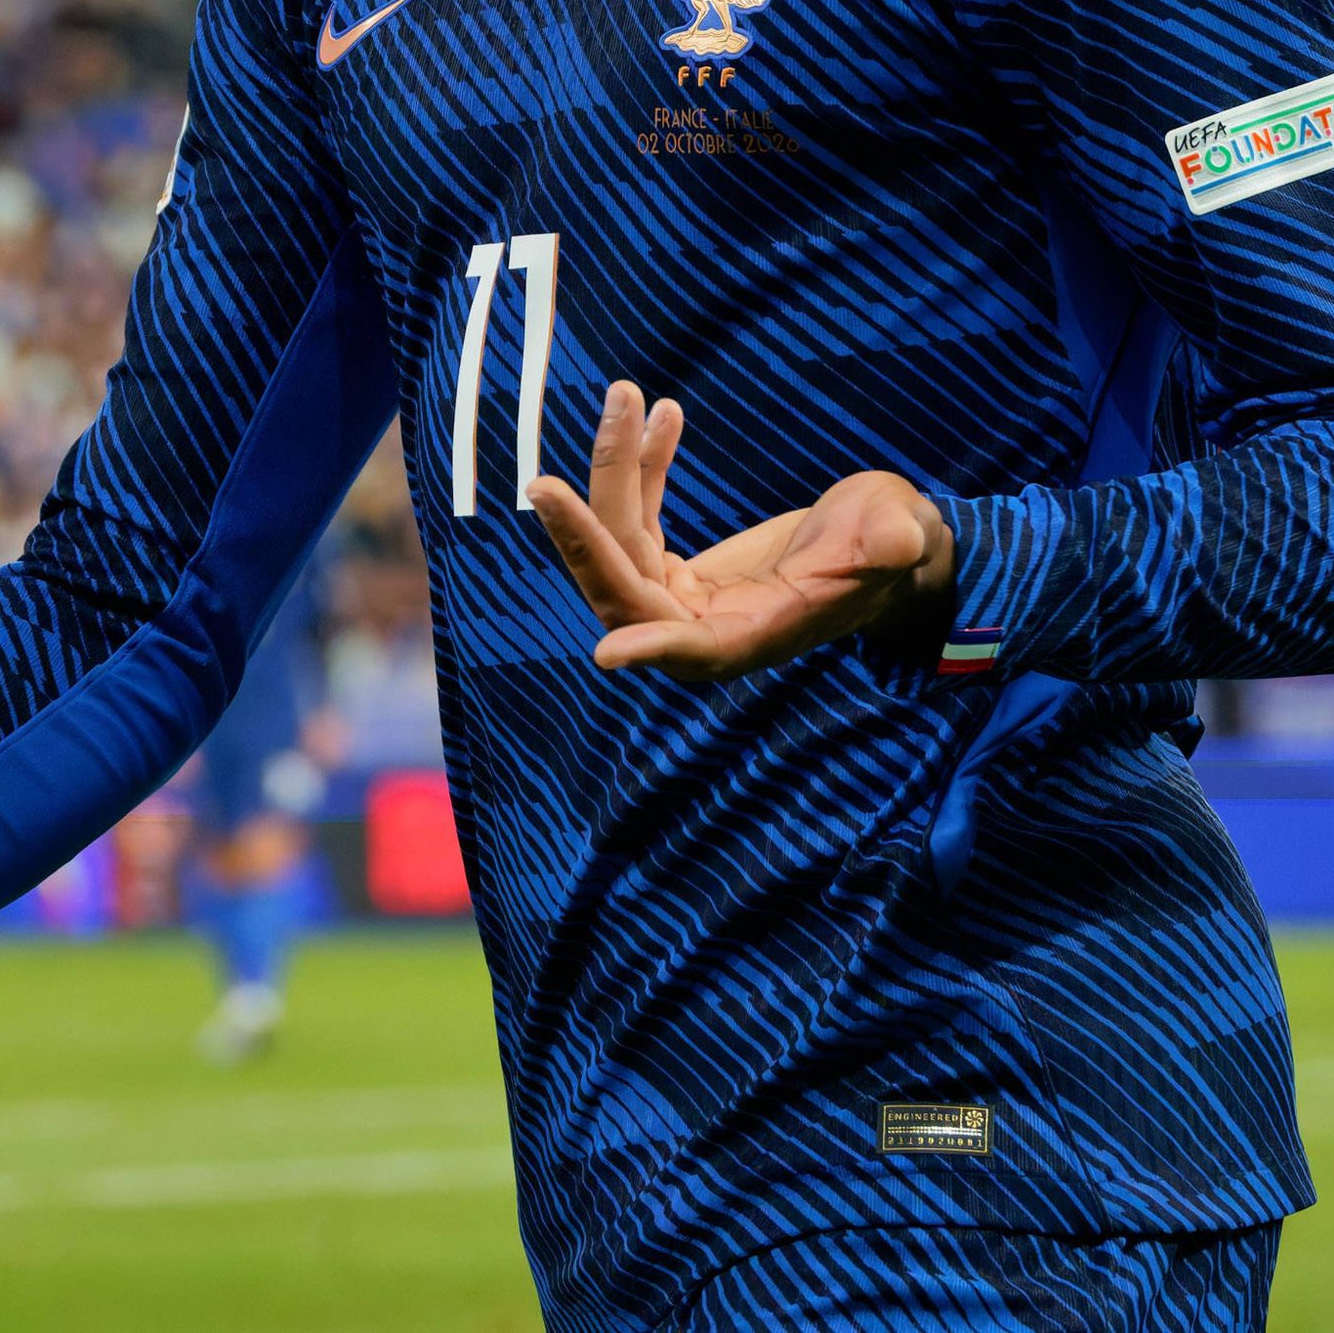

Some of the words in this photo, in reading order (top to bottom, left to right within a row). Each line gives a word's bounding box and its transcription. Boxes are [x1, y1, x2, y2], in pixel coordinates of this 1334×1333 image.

[678, 65, 736, 88] FFF
[654, 107, 707, 129] FRANCE
[725, 108, 775, 130] ITALIE
[637, 133, 660, 154] 02
[665, 132, 736, 154] OCTOBRE
[1174, 120, 1228, 154] UEFA
[452, 233, 560, 516] 11
[887, 1112, 959, 1122] ENGINEERED
